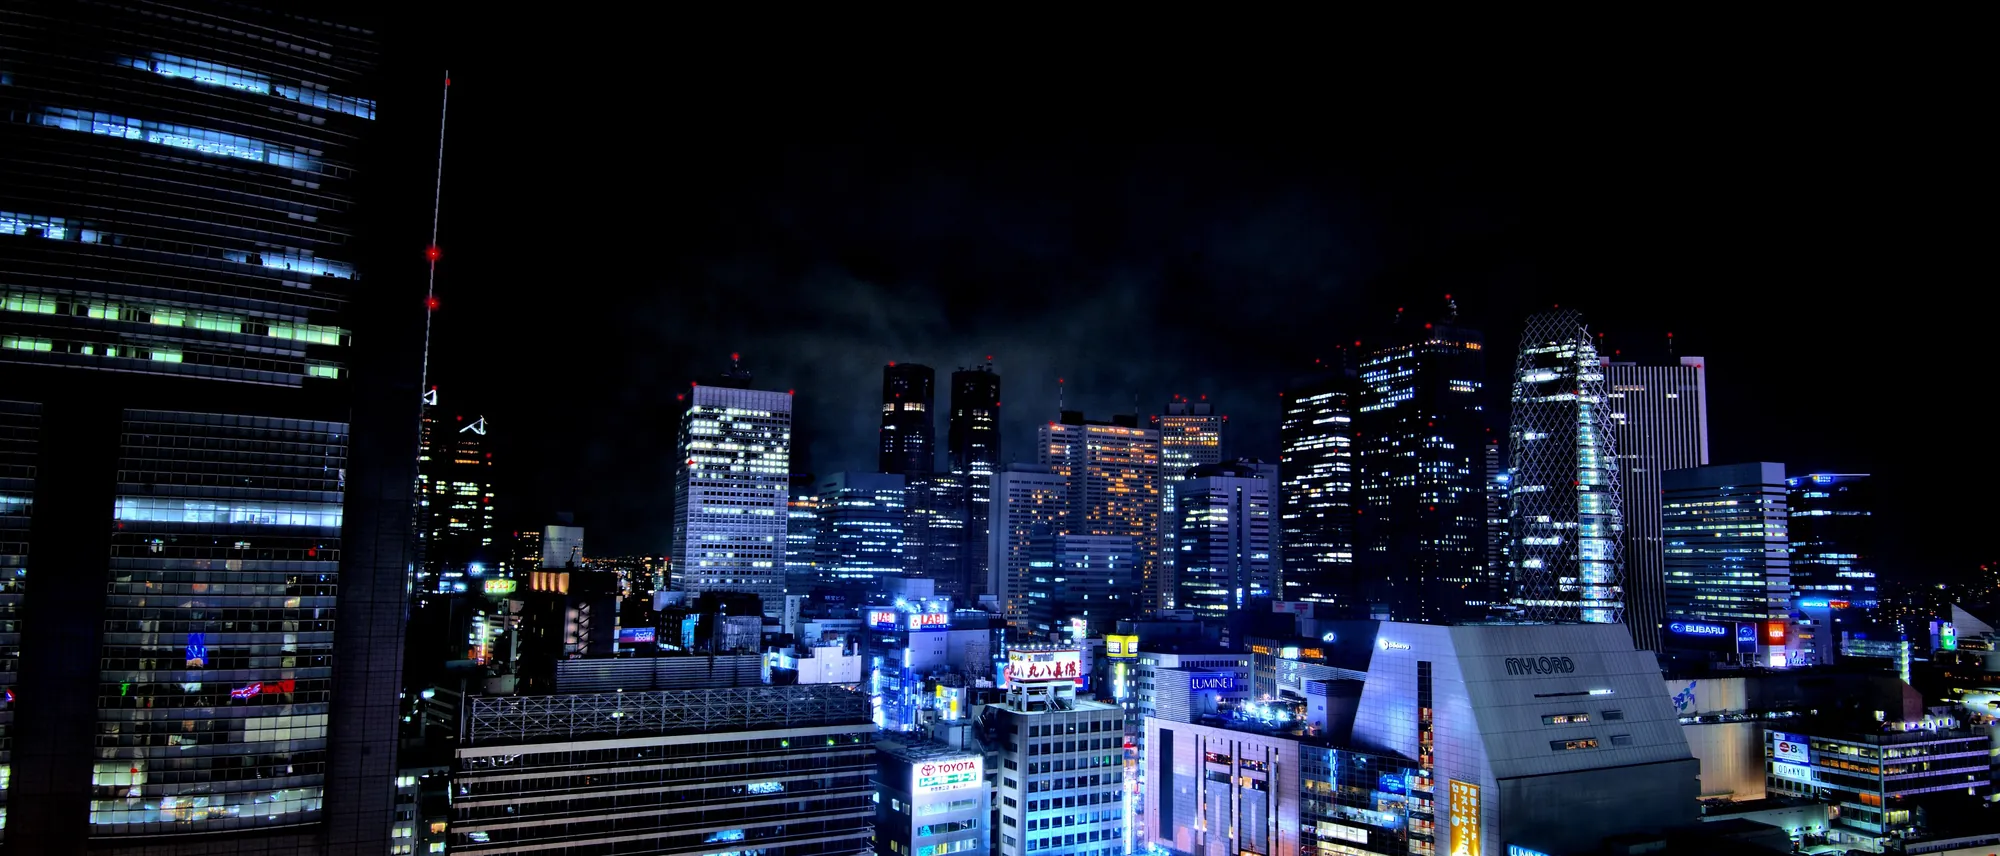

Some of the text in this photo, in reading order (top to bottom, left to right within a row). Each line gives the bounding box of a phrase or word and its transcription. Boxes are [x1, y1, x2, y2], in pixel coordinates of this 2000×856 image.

[921, 614, 945, 624] LABI
[1685, 625, 1725, 635] SUBARU
[1505, 656, 1575, 676] MYLORD
[938, 761, 975, 773] TOYOTA
